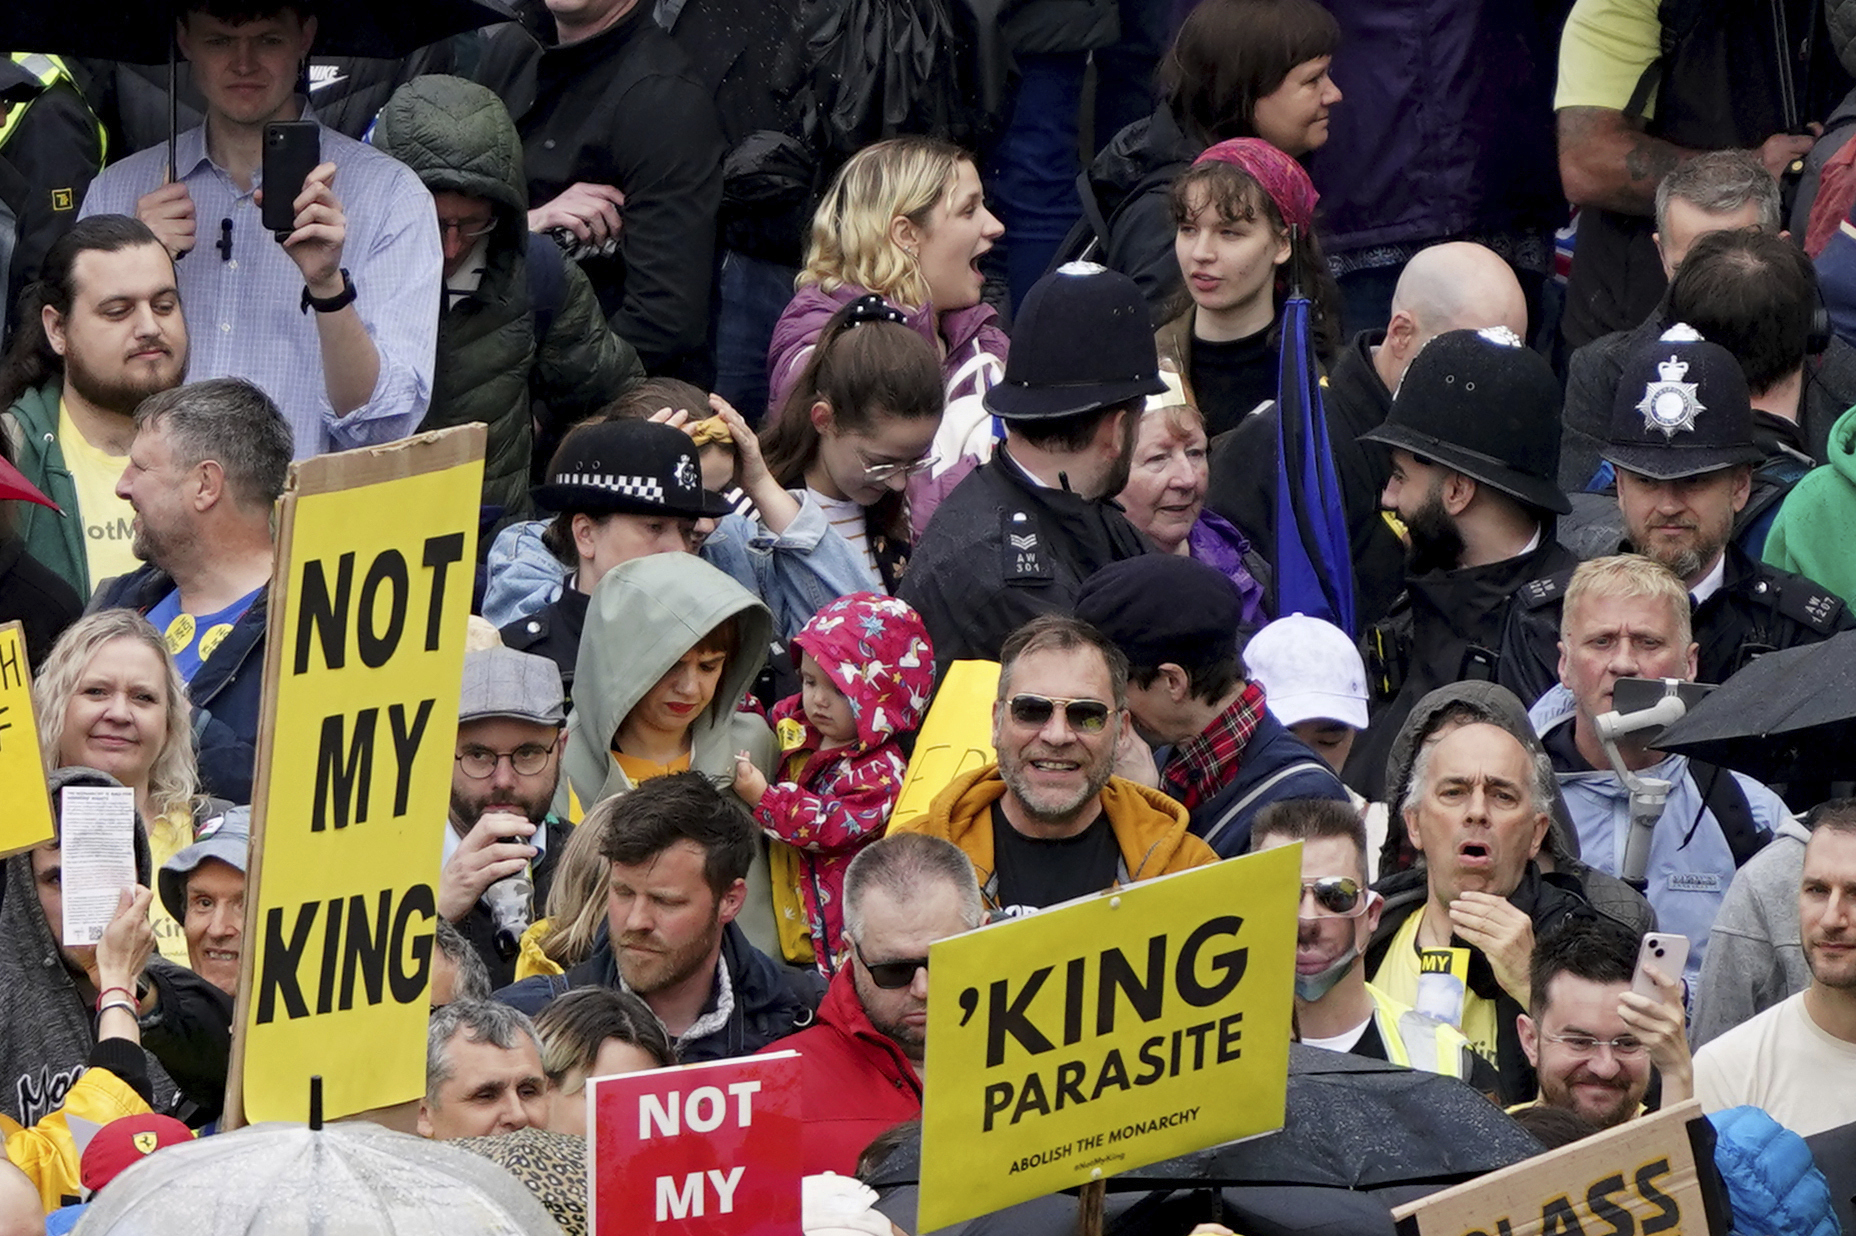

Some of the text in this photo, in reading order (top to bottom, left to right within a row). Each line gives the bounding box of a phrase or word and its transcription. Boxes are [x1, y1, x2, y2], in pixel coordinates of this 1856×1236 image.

[1016, 562, 1039, 573] 301
[1017, 553, 1035, 562] AW
[294, 530, 464, 675] NOT
[1805, 595, 1821, 613] AW
[1812, 597, 1834, 623] 1207
[311, 698, 436, 833] MY
[255, 883, 437, 1025] KING
[1422, 955, 1450, 971] MY
[982, 1011, 1245, 1133] PARASITE
[637, 1080, 762, 1141] NOT
[1008, 1106, 1201, 1175] ABOLISH THE MONARCHY
[1074, 1151, 1126, 1172] #NotMyKing
[654, 1166, 746, 1223] MY
